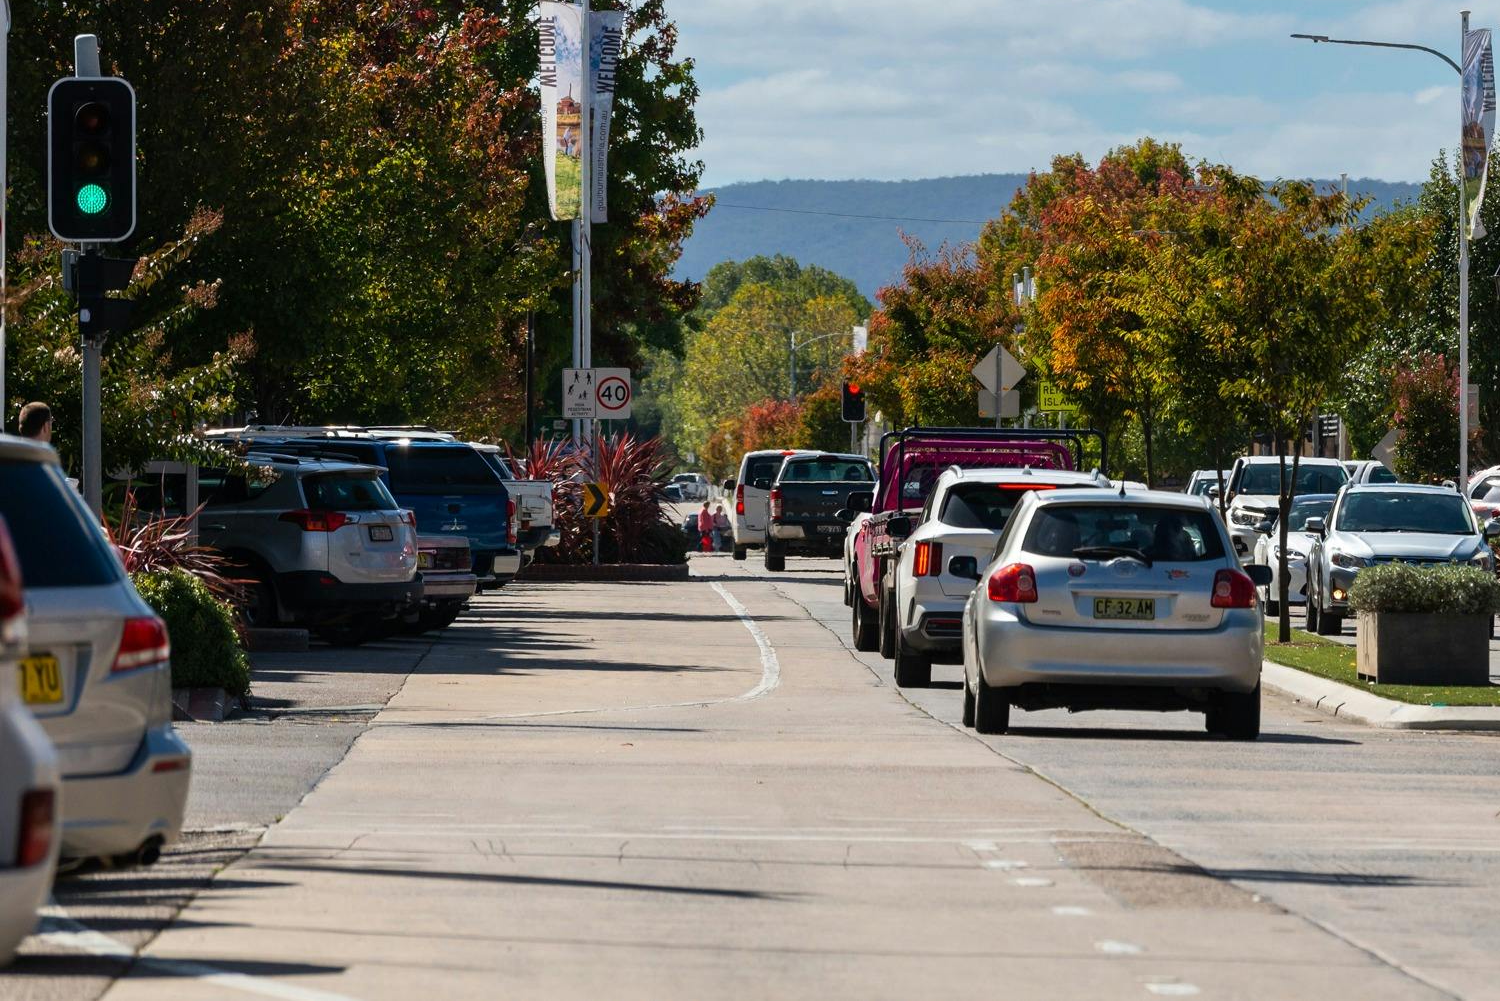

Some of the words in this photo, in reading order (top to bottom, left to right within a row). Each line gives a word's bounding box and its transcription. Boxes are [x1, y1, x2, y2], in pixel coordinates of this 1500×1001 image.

[595, 26, 625, 95] WELCOME
[600, 385, 627, 402] 40
[1096, 599, 1113, 615] CF
[1117, 600, 1133, 615] 32
[1136, 599, 1153, 615] AM
[33, 662, 59, 694] YU
